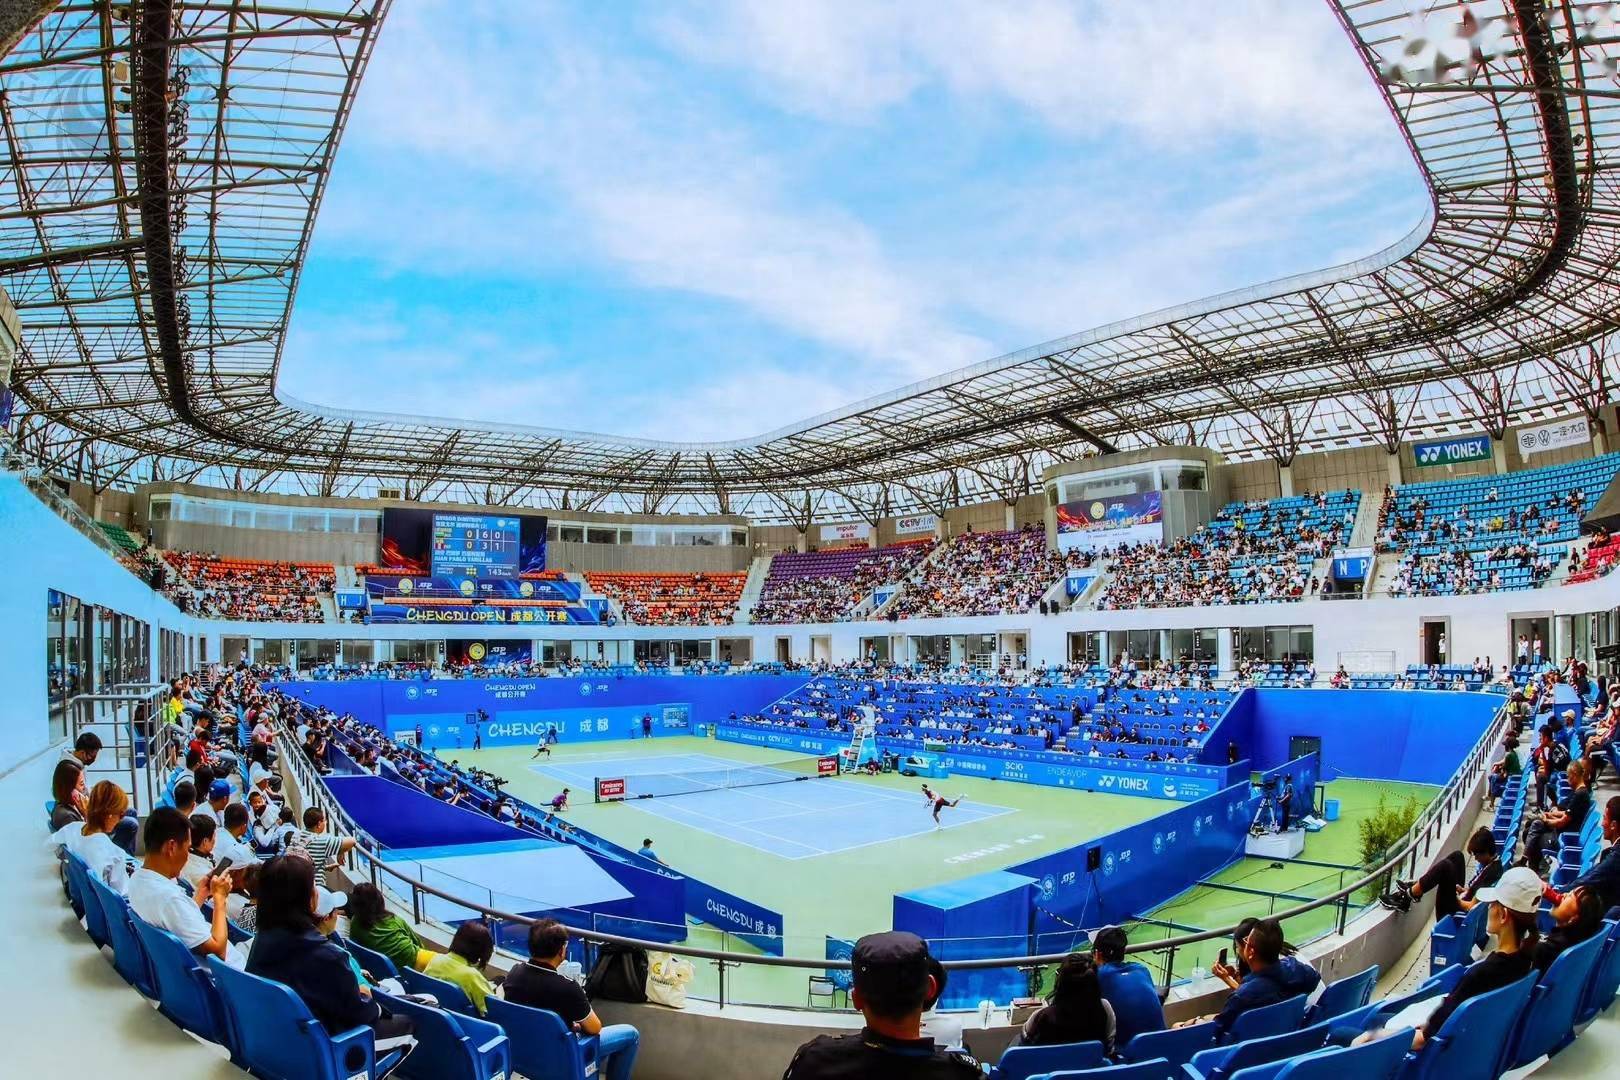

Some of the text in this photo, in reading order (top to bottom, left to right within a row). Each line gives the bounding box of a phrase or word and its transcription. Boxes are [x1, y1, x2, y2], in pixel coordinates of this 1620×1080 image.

[1443, 441, 1483, 460] YONEX
[467, 530, 500, 539] 0 6 0
[467, 541, 473, 549] 0
[1340, 559, 1367, 576] N P
[341, 595, 347, 606] H
[406, 607, 568, 622] CHENGDU OPEN 成都公开赛
[484, 683, 536, 691] CHENGDU OPEN
[488, 720, 565, 737] CHENGDU
[1117, 776, 1149, 791] YONEX
[706, 898, 753, 930] CHENGDU
